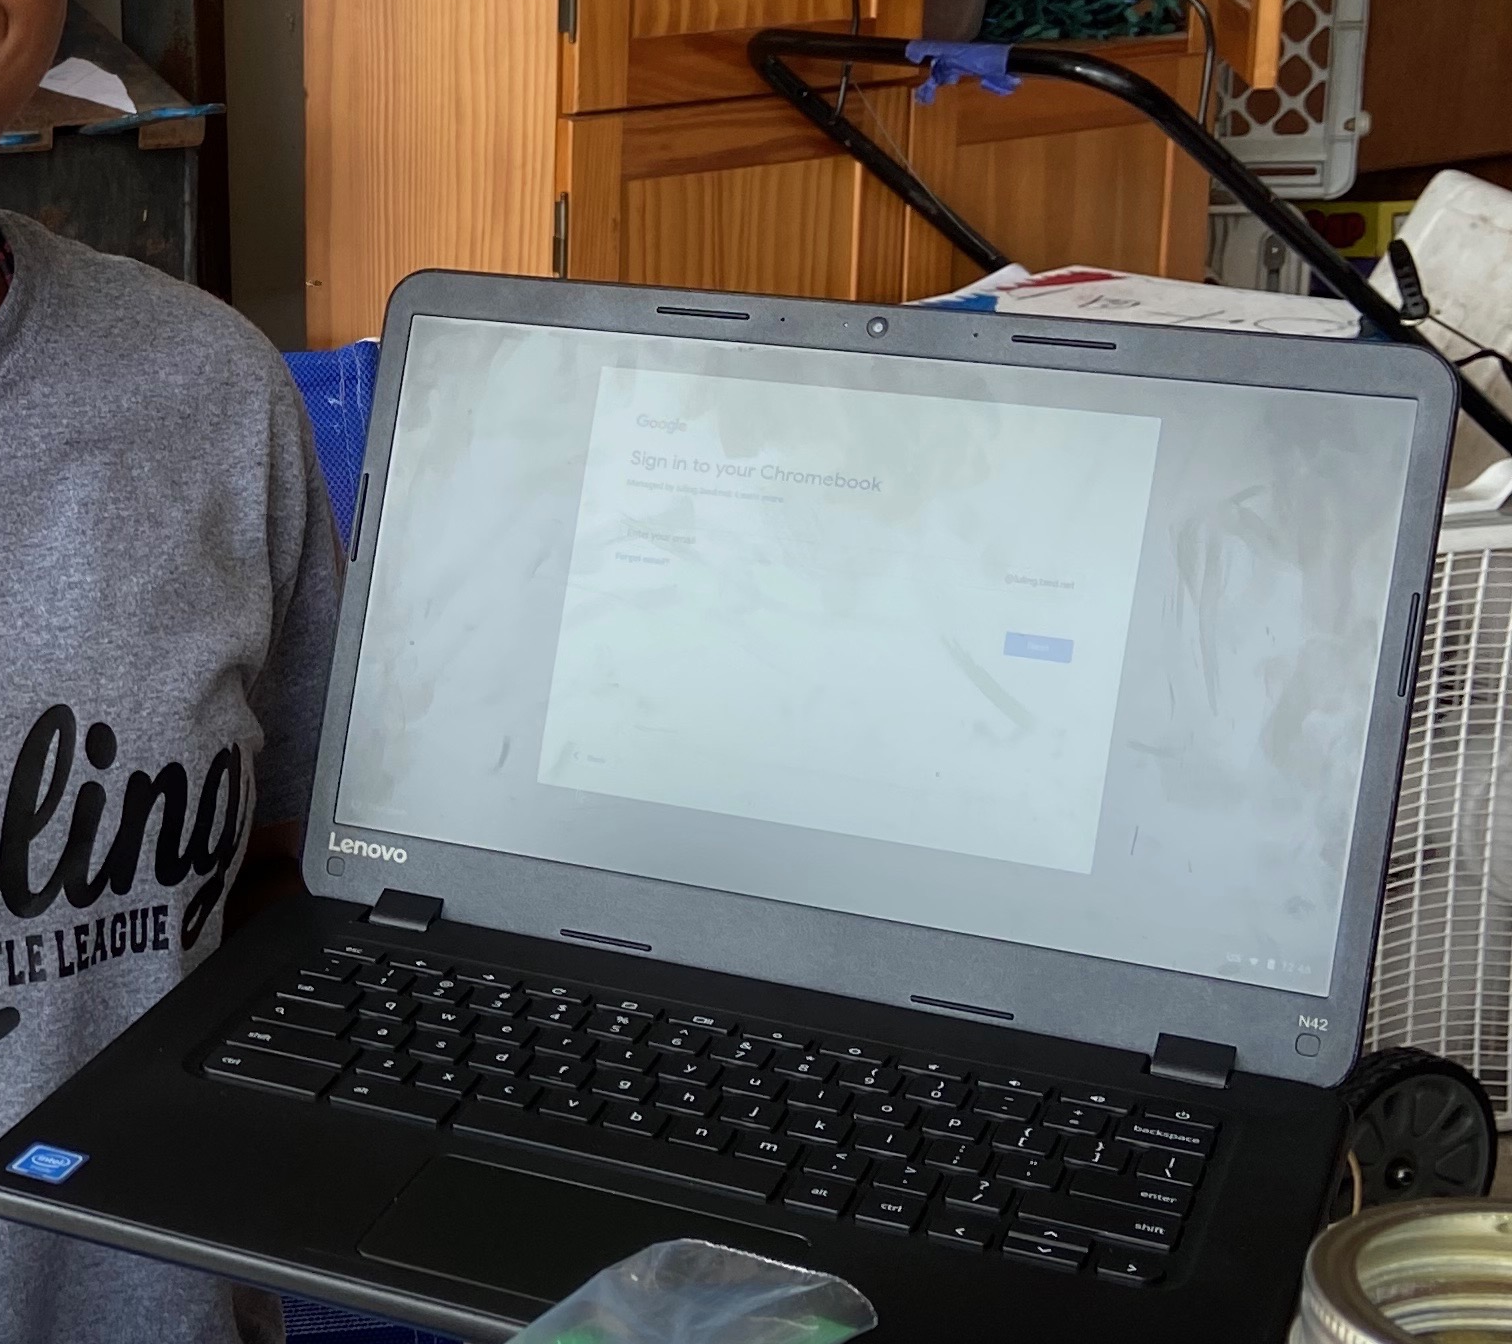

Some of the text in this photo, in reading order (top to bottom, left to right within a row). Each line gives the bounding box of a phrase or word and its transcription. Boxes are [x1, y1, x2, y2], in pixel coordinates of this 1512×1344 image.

[634, 411, 688, 435] Google
[629, 449, 883, 495] Sign in to your Chromebook
[626, 477, 663, 491] Managed
[626, 528, 695, 545] Enter your email
[614, 552, 640, 563] Forgot
[327, 830, 408, 864] Lenovo
[58, 906, 169, 978] LEAGUE
[1298, 1014, 1328, 1031] N42
